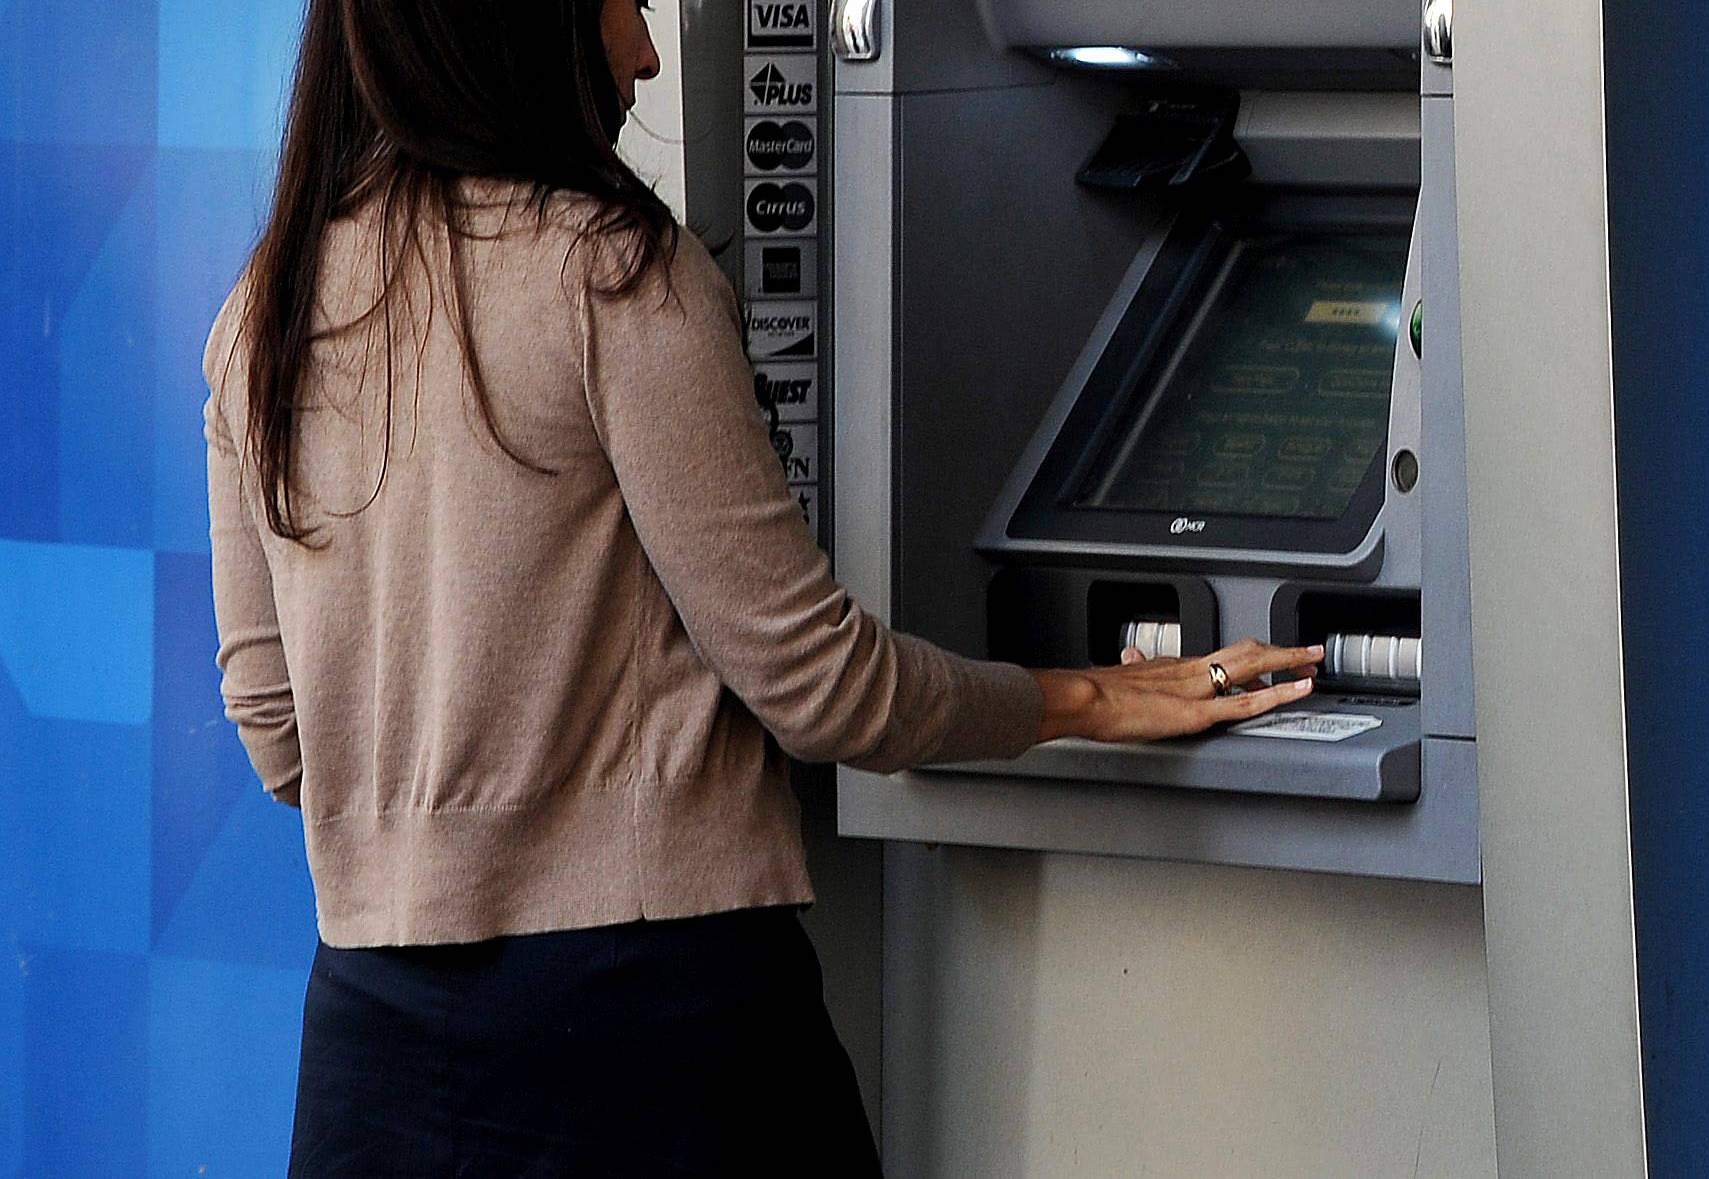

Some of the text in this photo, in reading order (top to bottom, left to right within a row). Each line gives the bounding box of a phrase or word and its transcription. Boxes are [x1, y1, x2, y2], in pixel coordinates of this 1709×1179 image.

[753, 4, 810, 29] VISA
[766, 83, 813, 106] PLUS
[749, 138, 813, 155] MasterCard
[755, 199, 806, 216] Cirrus
[751, 316, 810, 332] DISCOVER
